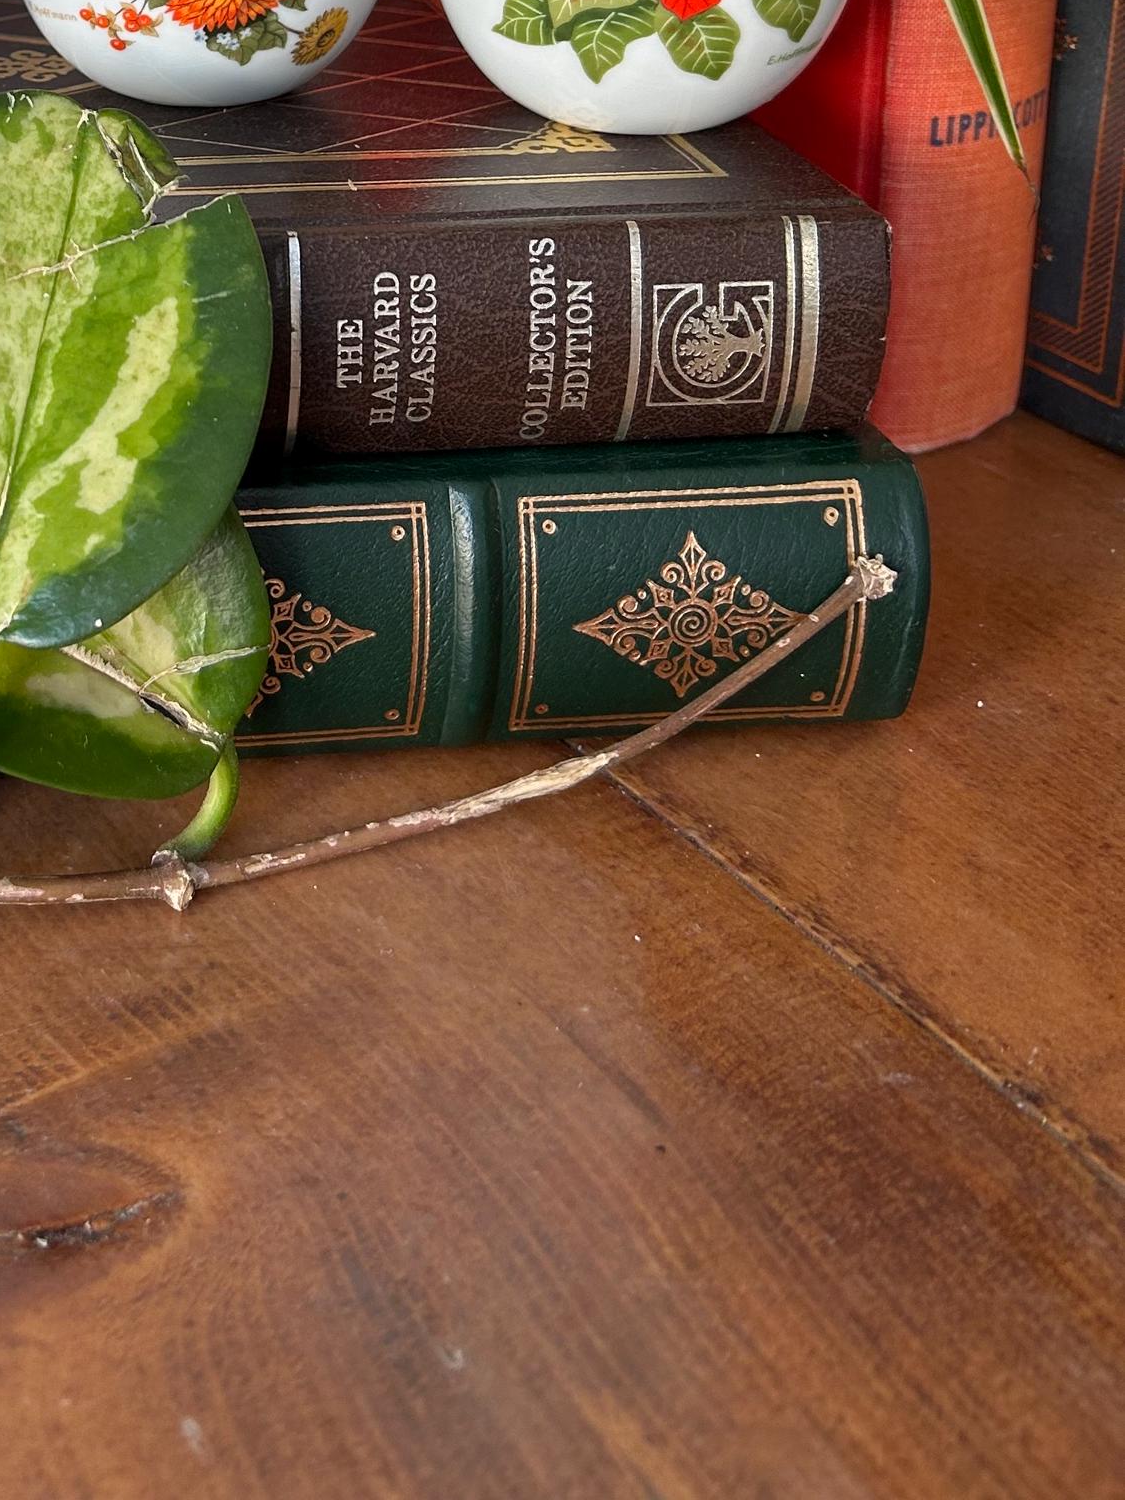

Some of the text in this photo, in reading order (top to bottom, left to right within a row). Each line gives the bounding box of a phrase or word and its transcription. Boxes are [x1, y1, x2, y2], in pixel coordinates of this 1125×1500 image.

[336, 318, 364, 389] THE
[368, 271, 401, 427] HARVARD
[404, 272, 438, 424] CLASSICS
[519, 236, 557, 441] COLLECTOR'S
[559, 278, 595, 412] EDITION
